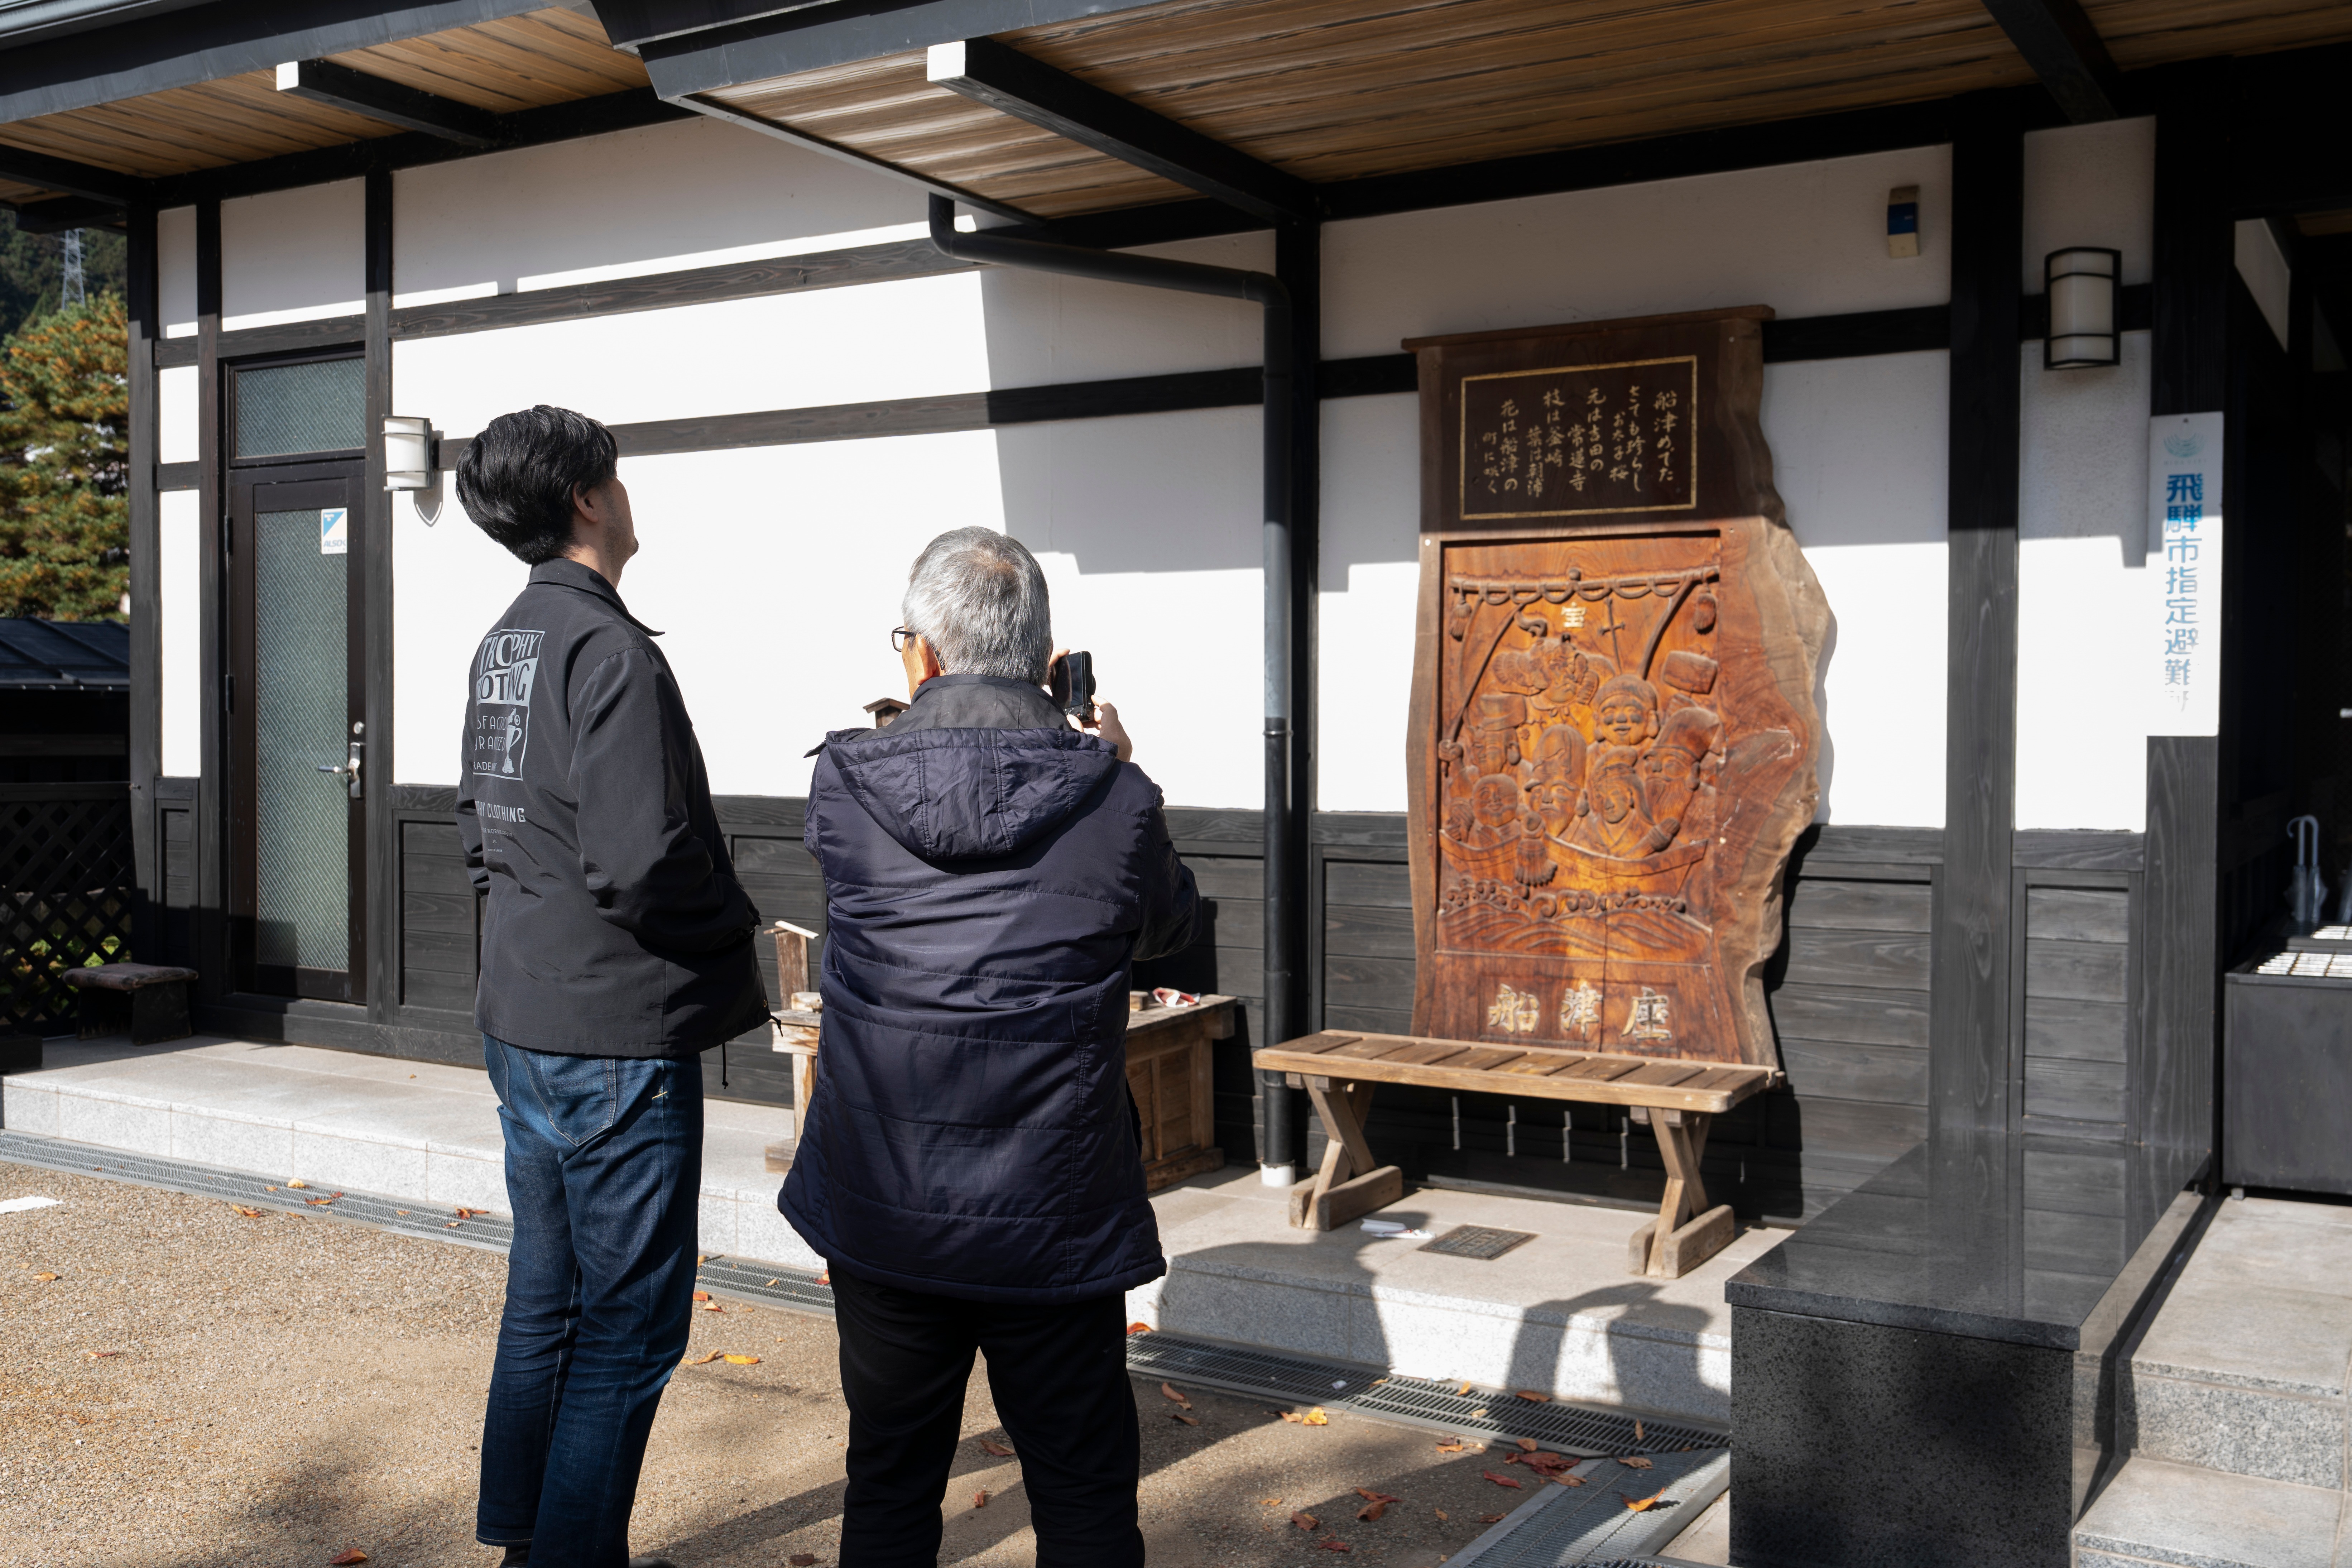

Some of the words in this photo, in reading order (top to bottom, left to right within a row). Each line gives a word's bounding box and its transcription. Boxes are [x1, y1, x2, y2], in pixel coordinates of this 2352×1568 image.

[1654, 390, 1677, 482] 船津めでた
[2165, 473, 2203, 713] 飛騨市指定避難
[480, 634, 540, 676] TROPHY
[487, 803, 526, 823] CLOTHING
[1488, 983, 1672, 1041] 船津座
